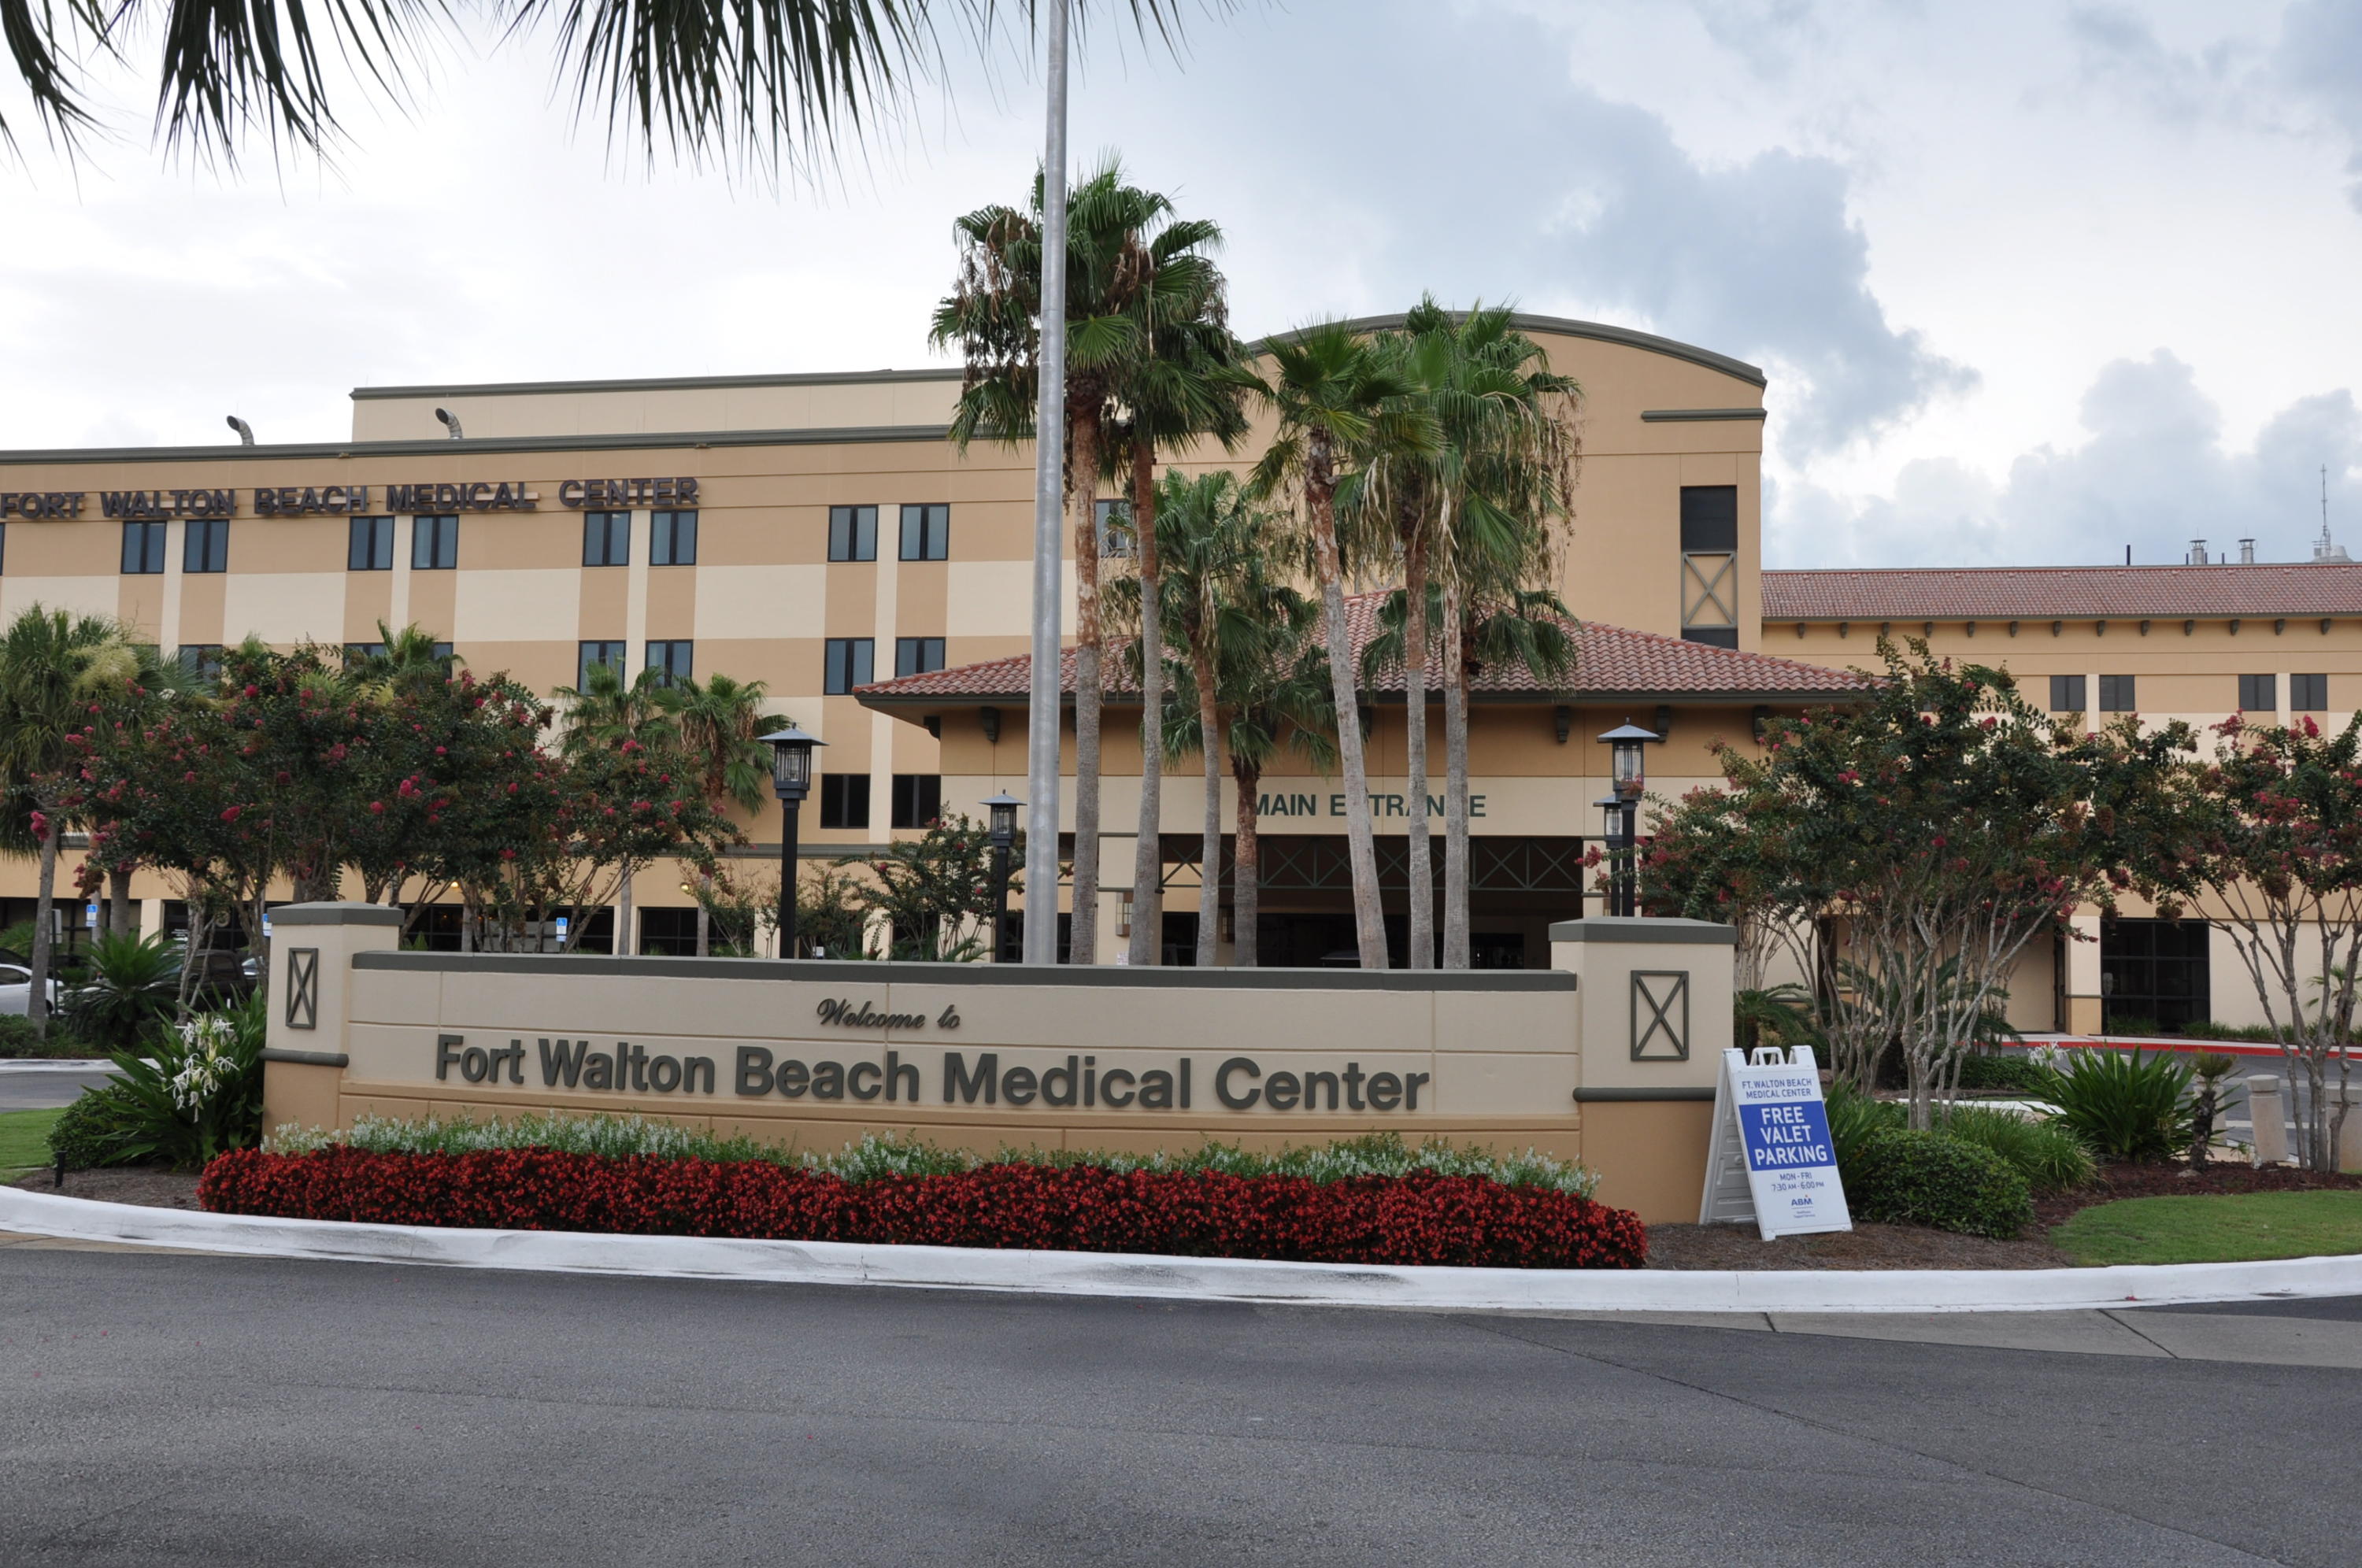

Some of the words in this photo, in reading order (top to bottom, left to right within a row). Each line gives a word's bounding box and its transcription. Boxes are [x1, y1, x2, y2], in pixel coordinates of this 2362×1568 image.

[0, 491, 84, 519] FORT
[100, 489, 236, 518] WALTON
[254, 485, 367, 515] BEACH
[387, 482, 535, 512] MEDICAL
[559, 477, 698, 507] CENTER
[1331, 794, 1486, 817] ETRNE
[817, 998, 926, 1029] Welcome
[937, 1004, 961, 1029] to
[435, 1034, 525, 1084] Fort
[539, 1038, 715, 1094] Walton
[735, 1045, 920, 1102] Beach
[944, 1052, 1191, 1109] Medical
[1216, 1057, 1430, 1111] Center
[1742, 1081, 1753, 1089] FT.
[1753, 1079, 1785, 1089] WALTON
[1786, 1078, 1812, 1087] BEACH
[1746, 1089, 1780, 1099] MEDICAL
[1782, 1088, 1812, 1097] CENTER
[1760, 1106, 1805, 1125] FREE
[1760, 1125, 1811, 1145] VALET
[1754, 1145, 1827, 1165] PARKING
